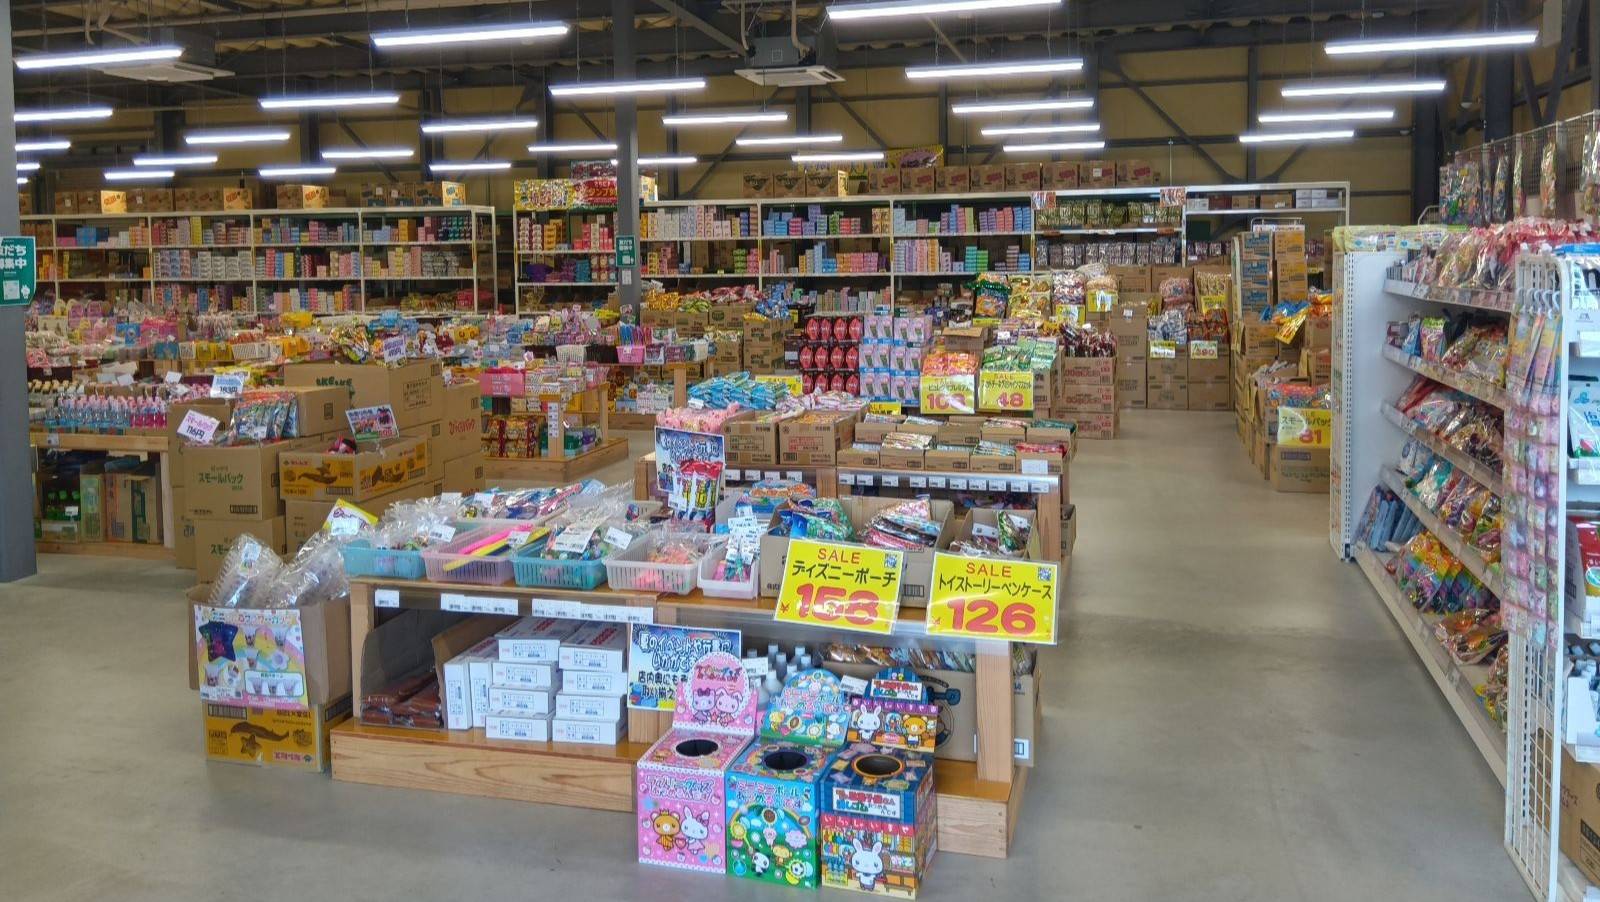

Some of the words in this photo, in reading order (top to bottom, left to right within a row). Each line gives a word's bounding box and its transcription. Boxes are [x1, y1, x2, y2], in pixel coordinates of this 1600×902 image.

[997, 391, 1024, 407] 48
[198, 472, 244, 484] スモールパック
[817, 548, 861, 565] SALE
[792, 560, 897, 588] ディズニーポーチ
[966, 562, 1012, 578] SALE
[939, 573, 1052, 600] トイストーリーペンケース
[796, 583, 880, 625] 158
[947, 598, 1036, 636] 126
